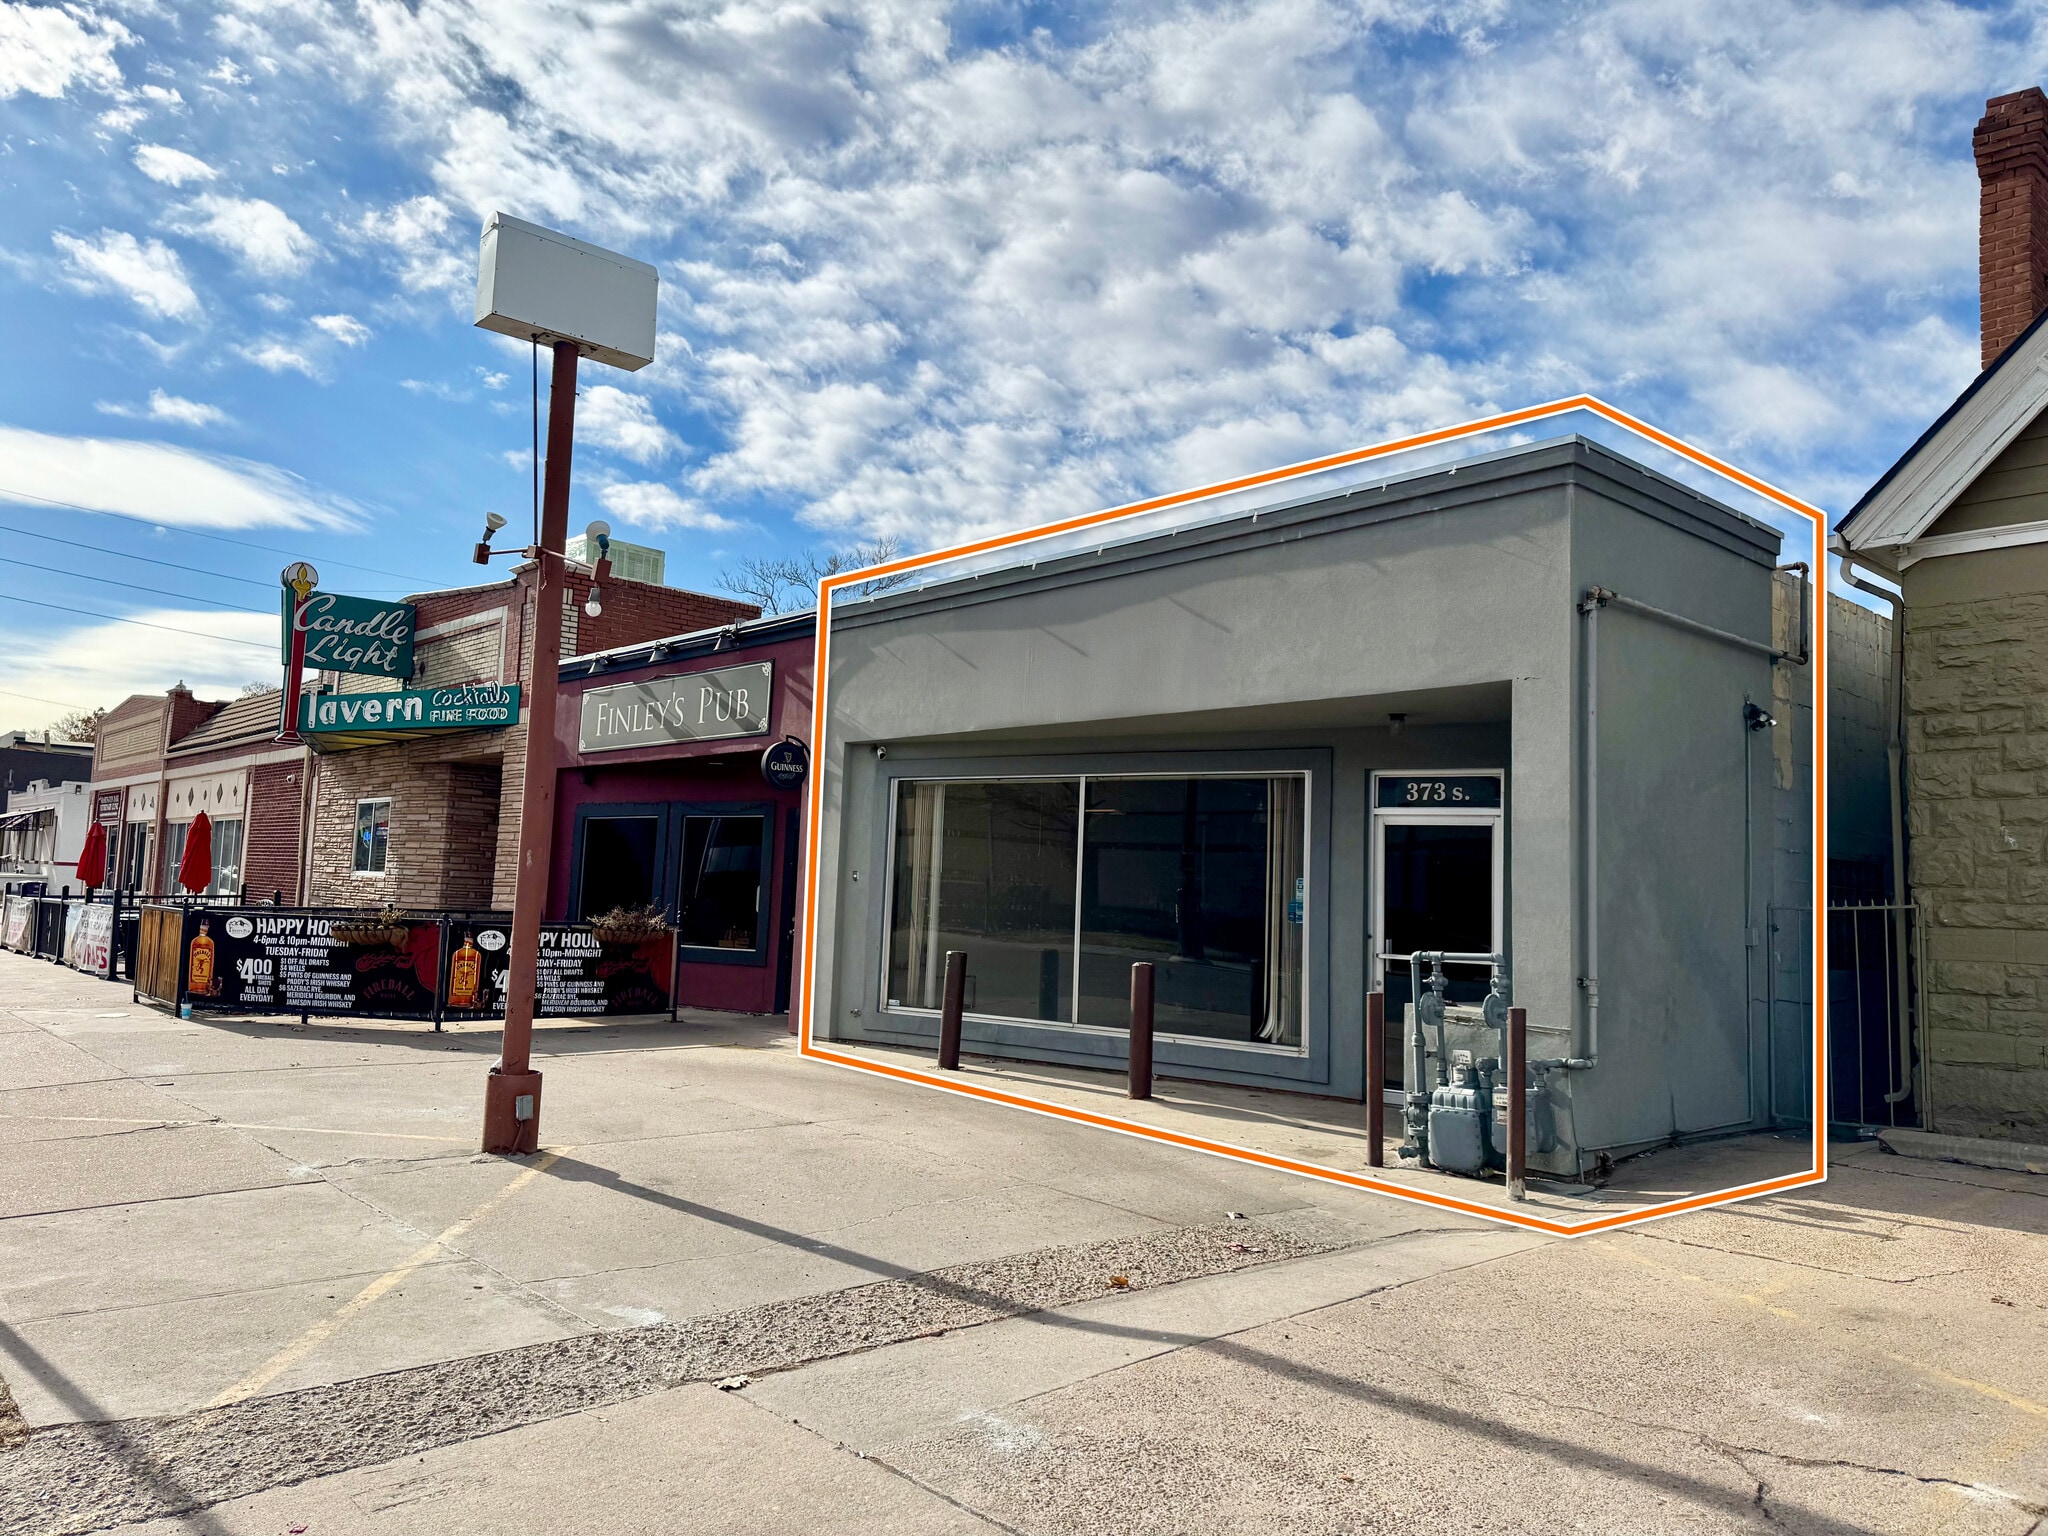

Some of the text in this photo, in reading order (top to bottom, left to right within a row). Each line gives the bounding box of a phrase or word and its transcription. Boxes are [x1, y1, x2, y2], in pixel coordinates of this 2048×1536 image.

[293, 594, 409, 645] Candle
[304, 634, 399, 672] Light
[432, 680, 510, 707] Cocktails
[303, 685, 423, 729] Tavern
[595, 686, 750, 737] FINLEY'S PUB
[429, 707, 509, 723] FINE FOOD
[770, 761, 804, 773] GUINNESS
[1406, 782, 1471, 802] 373 s.
[256, 917, 305, 935] HAPPY
[253, 934, 278, 946] 4-6pm
[278, 935, 286, 945] &
[265, 946, 329, 958] TUESDAY-FRIDAY
[541, 948, 603, 959] 10pm-MIDNIGHT
[298, 958, 308, 966] ALL
[308, 959, 330, 967] DRAFTS
[287, 971, 304, 979] PINTS
[311, 972, 340, 980] GUINNESS
[340, 973, 352, 981] AND
[244, 985, 270, 995] ALL DAY
[326, 980, 351, 988] WHISKEY
[239, 993, 274, 1003] EVERYDAY!
[286, 998, 353, 1009] JAMESON IRISH WHISKEY
